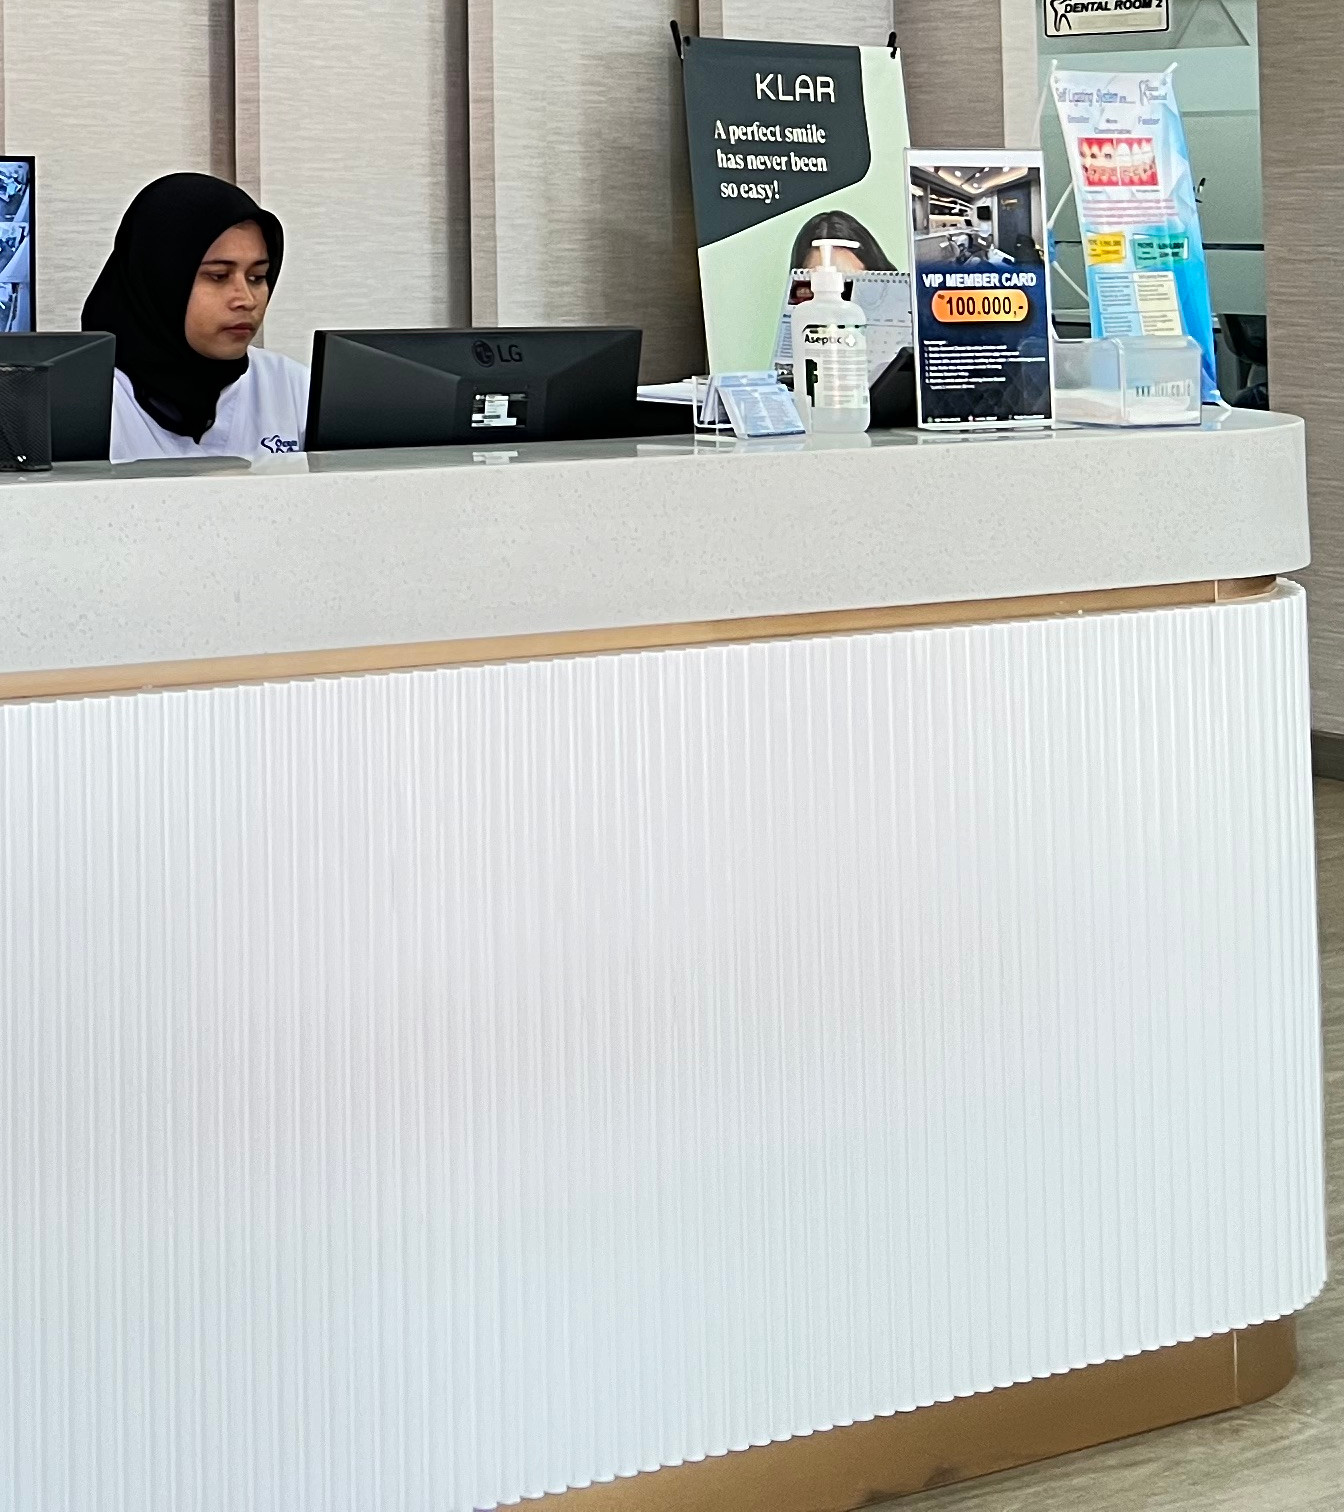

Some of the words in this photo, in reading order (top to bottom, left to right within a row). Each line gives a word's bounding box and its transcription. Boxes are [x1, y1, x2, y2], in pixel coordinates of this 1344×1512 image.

[1064, 0, 1112, 14] DENTAL
[755, 72, 836, 103] KLAR
[714, 119, 727, 140] A
[728, 121, 783, 145] perfect
[784, 123, 827, 144] smile
[716, 148, 745, 170] has
[746, 154, 788, 171] never
[789, 151, 828, 172] been
[720, 182, 739, 199] so
[739, 179, 780, 204] easy!
[922, 273, 944, 288] VIP
[945, 272, 1000, 287] MEMBER
[1001, 272, 1037, 287] CARD
[497, 344, 523, 363] LG
